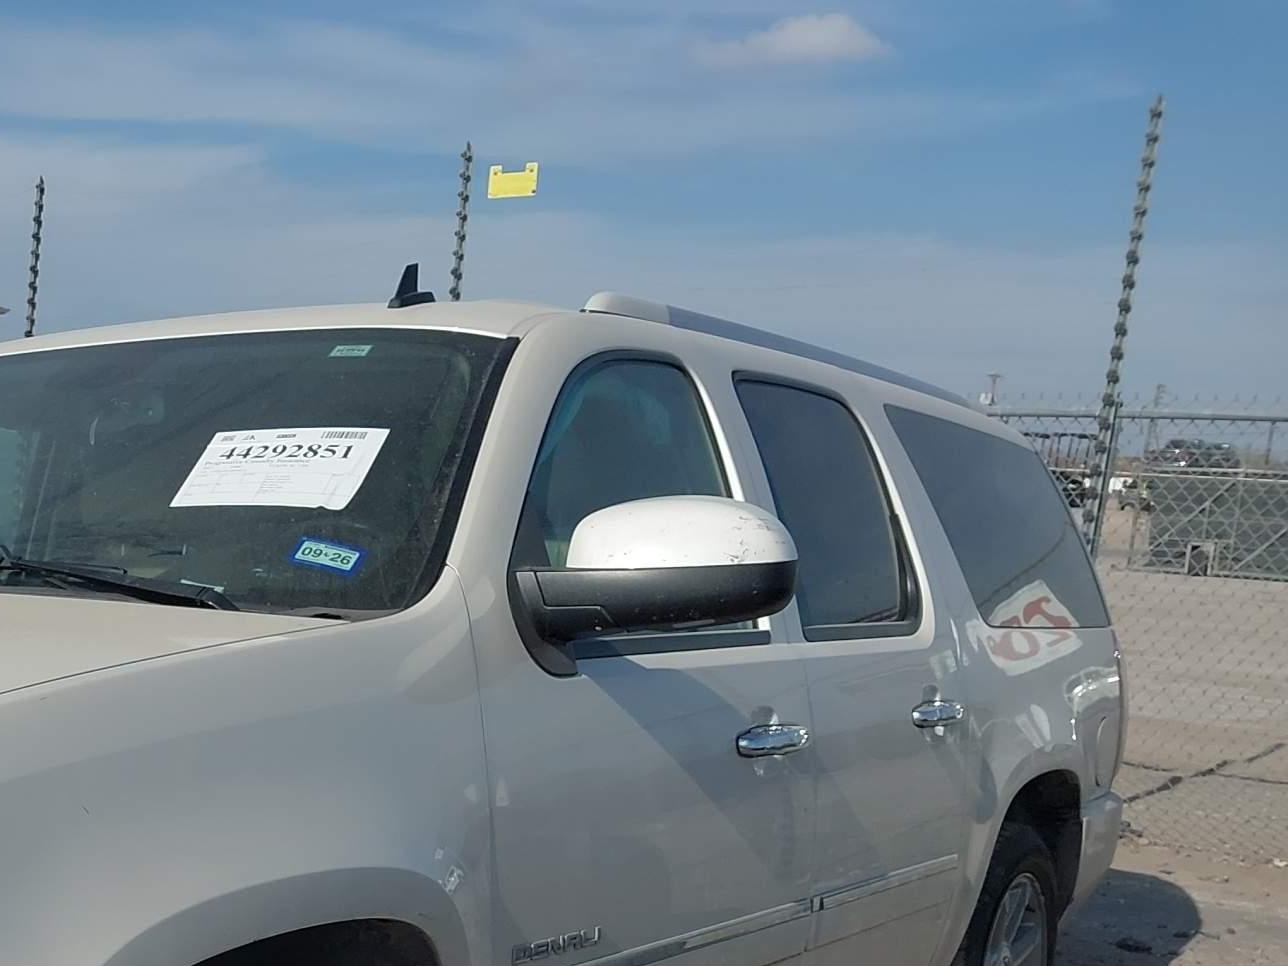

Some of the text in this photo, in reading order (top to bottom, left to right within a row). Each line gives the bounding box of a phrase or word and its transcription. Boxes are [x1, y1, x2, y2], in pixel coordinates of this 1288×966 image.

[218, 443, 355, 460] 44292851
[300, 545, 352, 566] 09 26
[511, 926, 601, 966] DENALI
